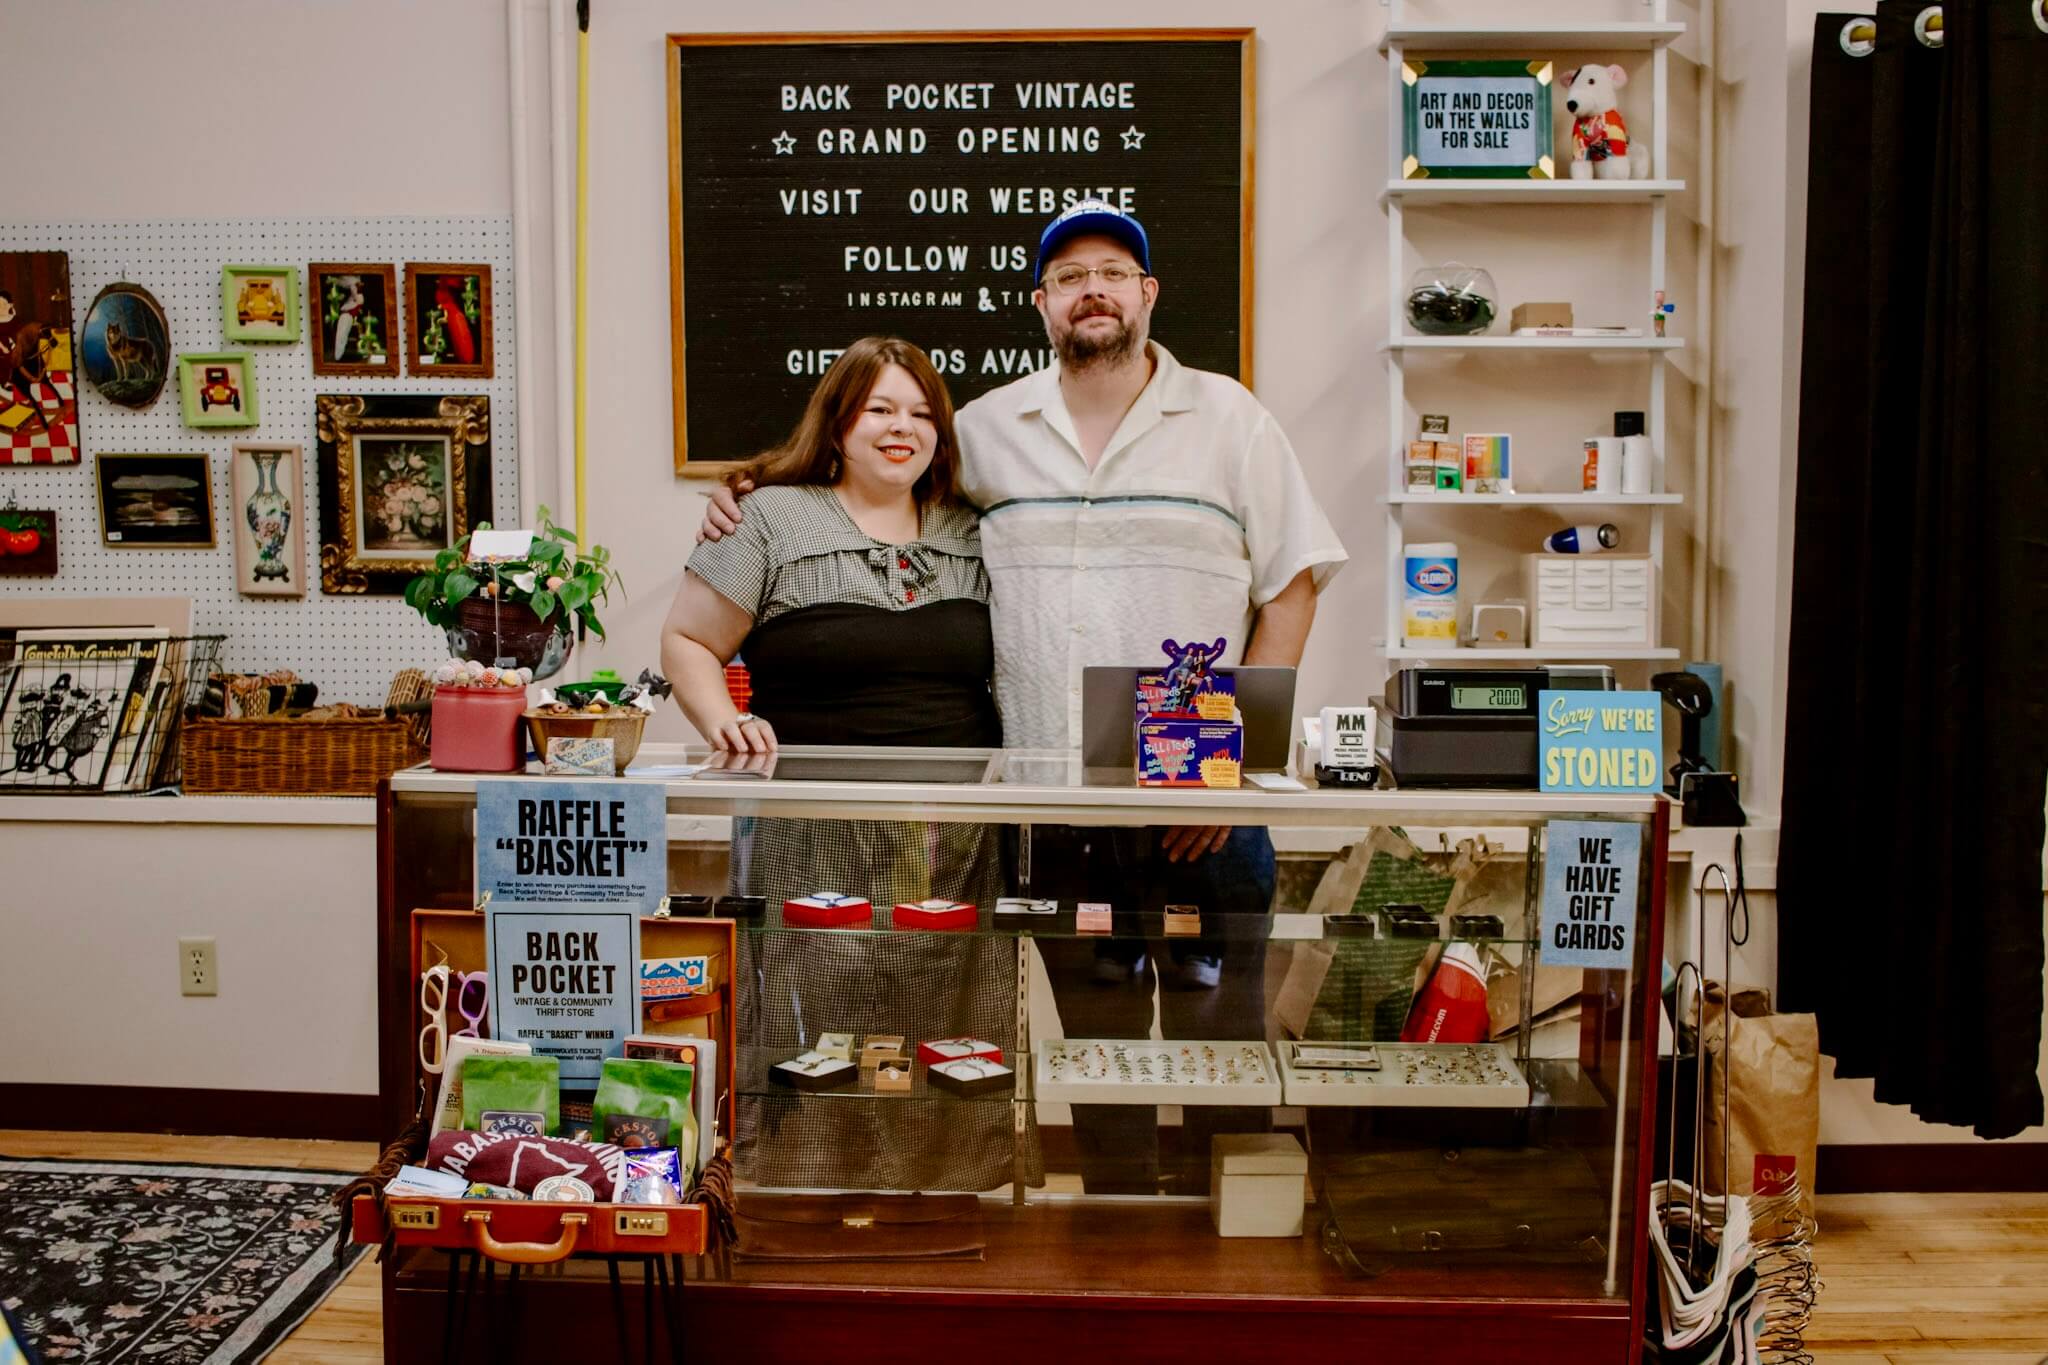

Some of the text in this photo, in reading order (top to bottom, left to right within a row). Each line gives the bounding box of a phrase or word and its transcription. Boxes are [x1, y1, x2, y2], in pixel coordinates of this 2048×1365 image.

[781, 82, 1135, 111] BACK POCKET VINTAGE
[1420, 93, 1534, 110] ART AND DECOR
[1425, 112, 1529, 129] ON THE WALLS
[817, 126, 1100, 154] GRAND OPENING
[1442, 131, 1509, 149] FOR SALE
[780, 189, 862, 215] VISIT
[909, 188, 968, 214] OUR
[844, 245, 1028, 272] FOLLOW US
[848, 292, 962, 307] INSTAGRAM
[978, 287, 997, 312] &
[1420, 572, 1451, 585] CLOR
[1457, 689, 1462, 704] T
[1336, 714, 1366, 731] MM
[1545, 696, 1655, 737] Sorry WE'RE
[1546, 747, 1657, 788] STONED
[518, 799, 626, 838] RAFFLE
[496, 838, 648, 877] “BASKET”
[1579, 837, 1612, 864] WE
[1566, 866, 1622, 893] HAVE
[1569, 895, 1614, 921] GIFT
[527, 932, 599, 961] BACK
[1554, 922, 1625, 950] CARDS
[512, 964, 616, 994] POCKET
[514, 998, 614, 1006] VINTAGE & COMMUNITY
[536, 1008, 595, 1016] THRIFT STORE
[518, 1030, 544, 1038] RAFFLE
[585, 1030, 614, 1040] WINNER
